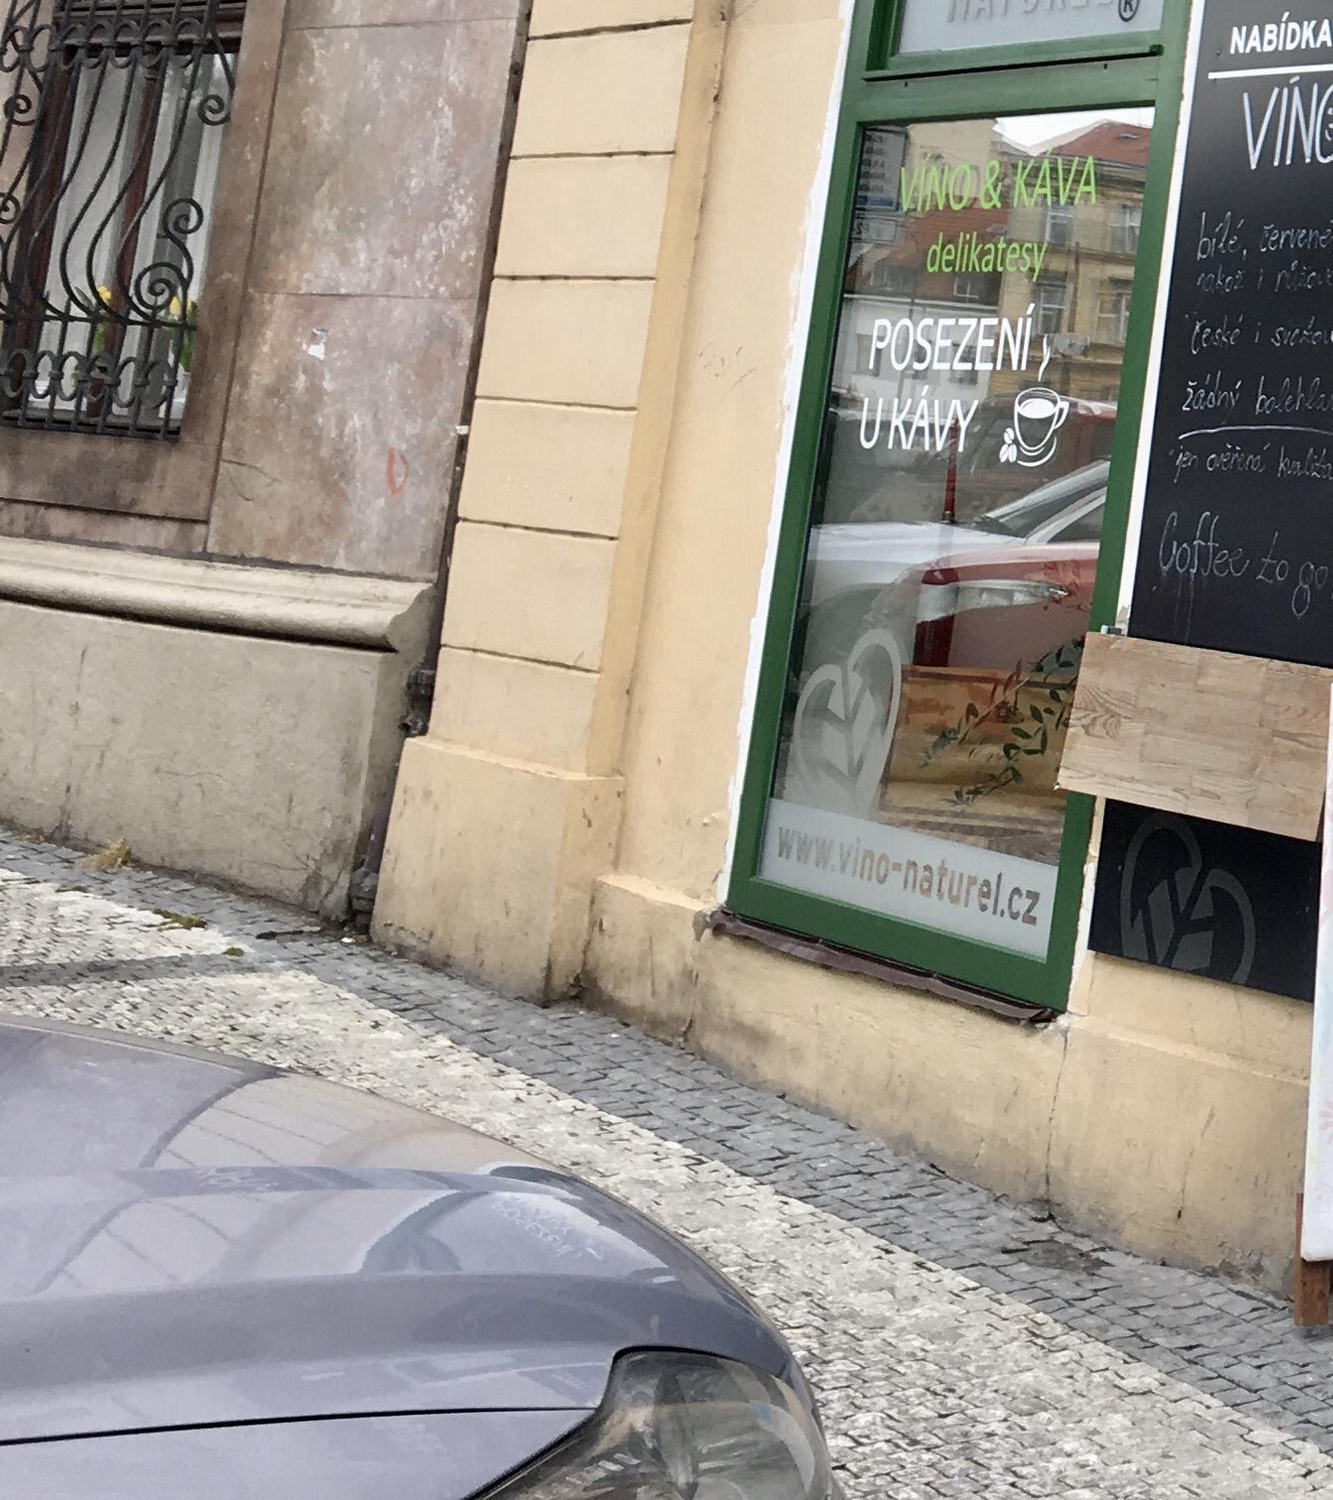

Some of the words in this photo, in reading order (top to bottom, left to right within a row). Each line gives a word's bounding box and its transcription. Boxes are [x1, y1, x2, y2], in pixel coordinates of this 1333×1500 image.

[1230, 12, 1333, 55] NABÍDKA
[901, 152, 972, 213] VÍNO
[980, 158, 1002, 211] &
[1013, 147, 1098, 209] KÁVA
[926, 231, 1048, 282] delikatesy
[867, 302, 1036, 372] POSEZENÍ
[859, 397, 883, 450] U
[887, 385, 980, 453] KÁVY
[1159, 511, 1250, 581] Coffee
[1256, 531, 1289, 584] to
[777, 826, 1041, 927] www.vino-naturel.cz
